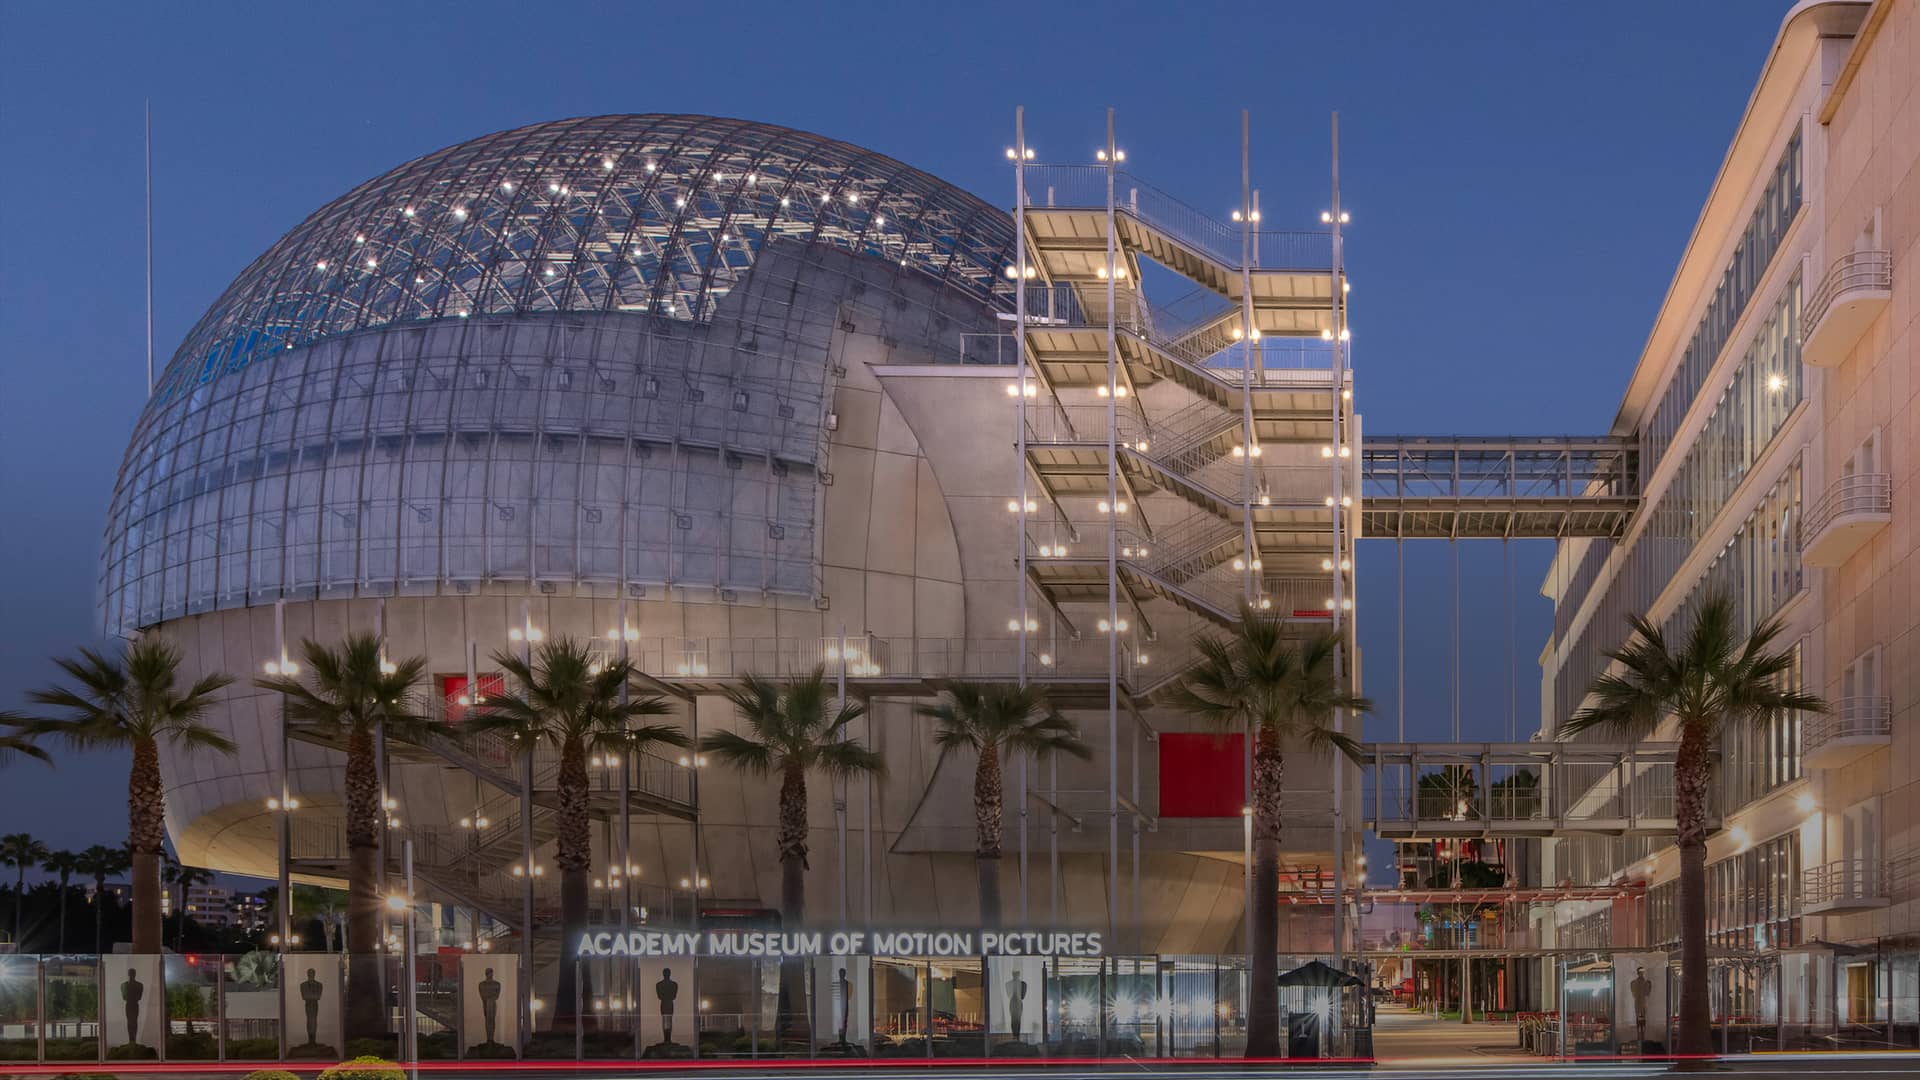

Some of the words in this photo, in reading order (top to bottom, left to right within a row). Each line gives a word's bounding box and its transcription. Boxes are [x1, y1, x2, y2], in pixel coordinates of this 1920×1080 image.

[577, 933, 701, 956] ACADEMY
[709, 933, 821, 956] MUSEUM
[830, 933, 865, 955] OF
[873, 933, 971, 956] MOTION
[981, 933, 1102, 956] PICTURES
